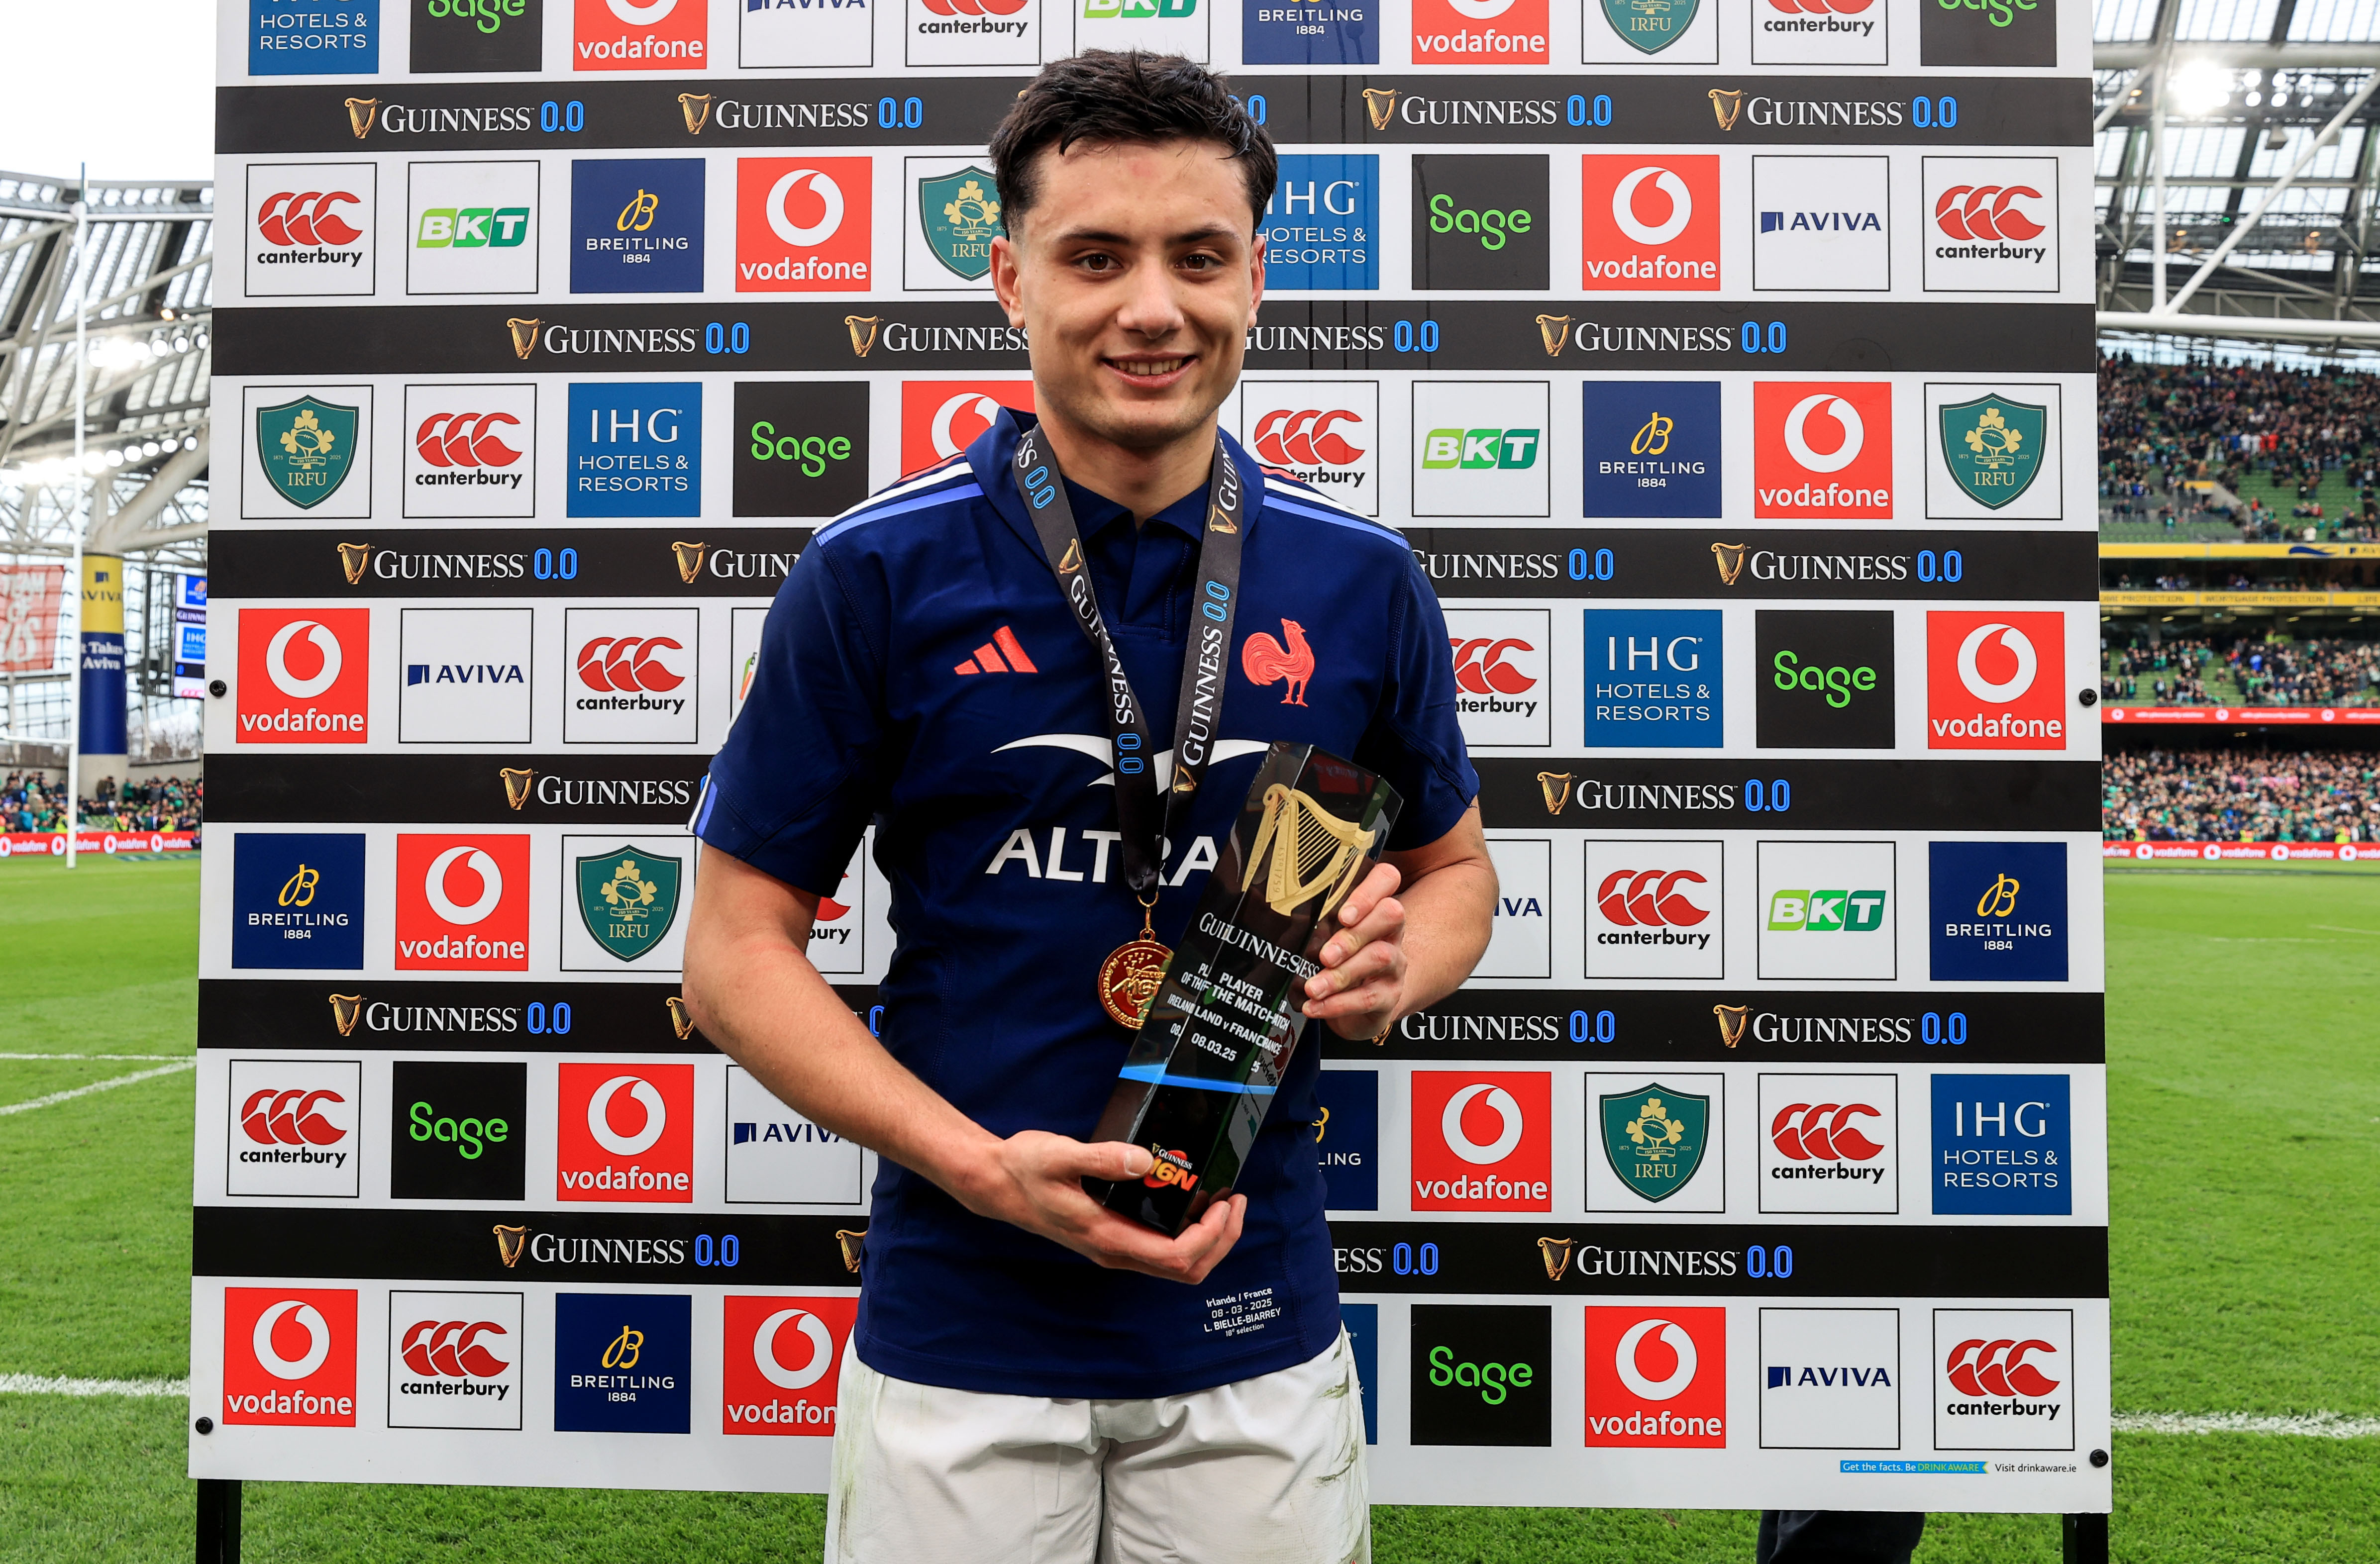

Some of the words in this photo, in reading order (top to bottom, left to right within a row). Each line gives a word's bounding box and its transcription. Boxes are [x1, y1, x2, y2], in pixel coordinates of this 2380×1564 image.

[261, 13, 348, 28] HOTELS
[355, 13, 366, 26] &
[1259, 9, 1362, 21] BREITLING
[1631, 17, 1671, 31] IRFU
[1764, 15, 1874, 36] canterbury
[919, 17, 1028, 37] canterbury
[1297, 26, 1324, 34] 1884
[261, 34, 366, 49] RESORTS
[578, 35, 703, 58] vodafone
[1416, 29, 1545, 52] vodafone
[382, 105, 530, 132] GUINNESS
[541, 101, 583, 132] 0.0
[716, 100, 868, 128] GUINNESS
[879, 97, 922, 128] 0.0
[1402, 97, 1556, 124] GUINNESS
[1567, 95, 1611, 126] 0.0
[1748, 97, 1902, 125] GUINNESS
[1913, 97, 1957, 127] 0.0
[419, 211, 527, 244] BKT
[1431, 194, 1531, 250] Sage
[1790, 212, 1881, 231] AVIVA
[587, 238, 688, 250] BREITLING
[952, 241, 993, 260] IRFU
[1936, 242, 2046, 263] canterbury
[258, 247, 362, 267] canterbury
[623, 254, 650, 263] 1884
[740, 256, 867, 280] vodafone
[1587, 255, 1716, 279] vodafone
[544, 325, 695, 353] GUINNESS
[706, 322, 749, 354] 0.0
[1394, 320, 1439, 352] 0.0
[1575, 323, 1731, 351] GUINNESS
[1742, 321, 1786, 353] 0.0
[592, 409, 677, 442] IHG
[751, 421, 850, 477] Sage
[1424, 433, 1537, 465] BKT
[580, 456, 669, 470] HOTELS
[676, 455, 688, 469] &
[1600, 462, 1704, 474] BREITLING
[288, 473, 327, 486] IRFU
[415, 469, 522, 489] canterbury
[580, 477, 688, 491] RESORTS
[1025, 466, 1055, 509] 0.0
[1638, 479, 1666, 487] 1884
[1974, 472, 2015, 486] IRFU
[1759, 483, 1889, 506] vodafone
[374, 551, 523, 579] GUINNESS
[534, 548, 577, 580] 0.0
[1569, 549, 1613, 580] 0.0
[1751, 551, 1907, 580] GUINNESS
[1918, 550, 1962, 582] 0.0
[1609, 637, 1697, 671] IHG
[436, 665, 524, 683] AVIVA
[1183, 626, 1223, 766] GUINNESS
[1203, 581, 1230, 622] 0.0
[1774, 651, 1876, 708] Sage
[1597, 684, 1690, 698] HOTELS
[1697, 684, 1709, 698] &
[577, 693, 685, 714] canterbury
[1597, 706, 1709, 720] RESORTS
[241, 708, 364, 731] vodafone
[1932, 713, 2063, 737] vodafone
[1117, 733, 1143, 774] 0.0
[538, 776, 689, 804] GUINNESS
[1577, 780, 1734, 809] GUINNESS
[1745, 780, 1790, 811] 0.0
[249, 913, 348, 926] BREITLING
[1769, 894, 1883, 927] BKT
[285, 930, 311, 939] 1884
[609, 924, 649, 938] IRFU
[1598, 928, 1710, 950] canterbury
[1947, 924, 2051, 936] BREITLING
[400, 935, 525, 959] vodafone
[1985, 941, 2013, 950] 1884
[1220, 972, 1263, 1001] PLAYER
[366, 1002, 517, 1032] GUINNESS
[528, 1002, 571, 1034] 0.0
[1400, 1011, 1558, 1041] GUINNESS
[1570, 1010, 1615, 1043] 0.0
[1753, 1013, 1911, 1042] GUINNESS
[1922, 1012, 1966, 1045] 0.0
[1191, 1033, 1237, 1061] 08.03.25
[410, 1102, 508, 1159] Sage
[1957, 1102, 2049, 1137] IHG
[240, 1147, 347, 1168] canterbury
[1158, 1148, 1193, 1170] GUINNESS
[1945, 1150, 2038, 1165] HOTELS
[2045, 1151, 2058, 1165] &
[562, 1166, 689, 1190] vodafone
[1635, 1164, 1677, 1177] IRFU
[1772, 1159, 1885, 1184] canterbury
[1945, 1173, 2058, 1187] RESORTS
[1416, 1175, 1548, 1199] vodafone
[531, 1234, 684, 1264] GUINNESS
[695, 1234, 739, 1267] 0.0
[1394, 1243, 1438, 1275] 0.0
[1577, 1246, 1736, 1275] GUINNESS
[1748, 1246, 1792, 1278] 0.0
[1206, 1295, 1237, 1307] Irlande
[1244, 1287, 1272, 1299] France
[1212, 1309, 1223, 1318] 08
[1231, 1305, 1242, 1314] 03
[1250, 1298, 1272, 1310] 2025
[1204, 1323, 1212, 1332] L.
[1214, 1307, 1281, 1330] BIELLE-BIARREY
[571, 1375, 674, 1388] BREITLING
[1430, 1346, 1532, 1404] Sage
[1798, 1368, 1891, 1386] AVIVA
[401, 1376, 510, 1400] canterbury
[609, 1392, 636, 1402] 1884
[227, 1390, 353, 1415] vodafone
[727, 1399, 837, 1424] vodafon
[1947, 1398, 2061, 1420] canterbury
[1589, 1411, 1722, 1436] vodafone
[1843, 1462, 1860, 1471] Get
[1862, 1462, 1877, 1471] the
[1879, 1462, 1903, 1472] facts.
[1905, 1463, 1916, 1472] Be
[1918, 1463, 1979, 1472] DRINKAWARE
[2018, 1464, 2076, 1472] drinkaware.ie
